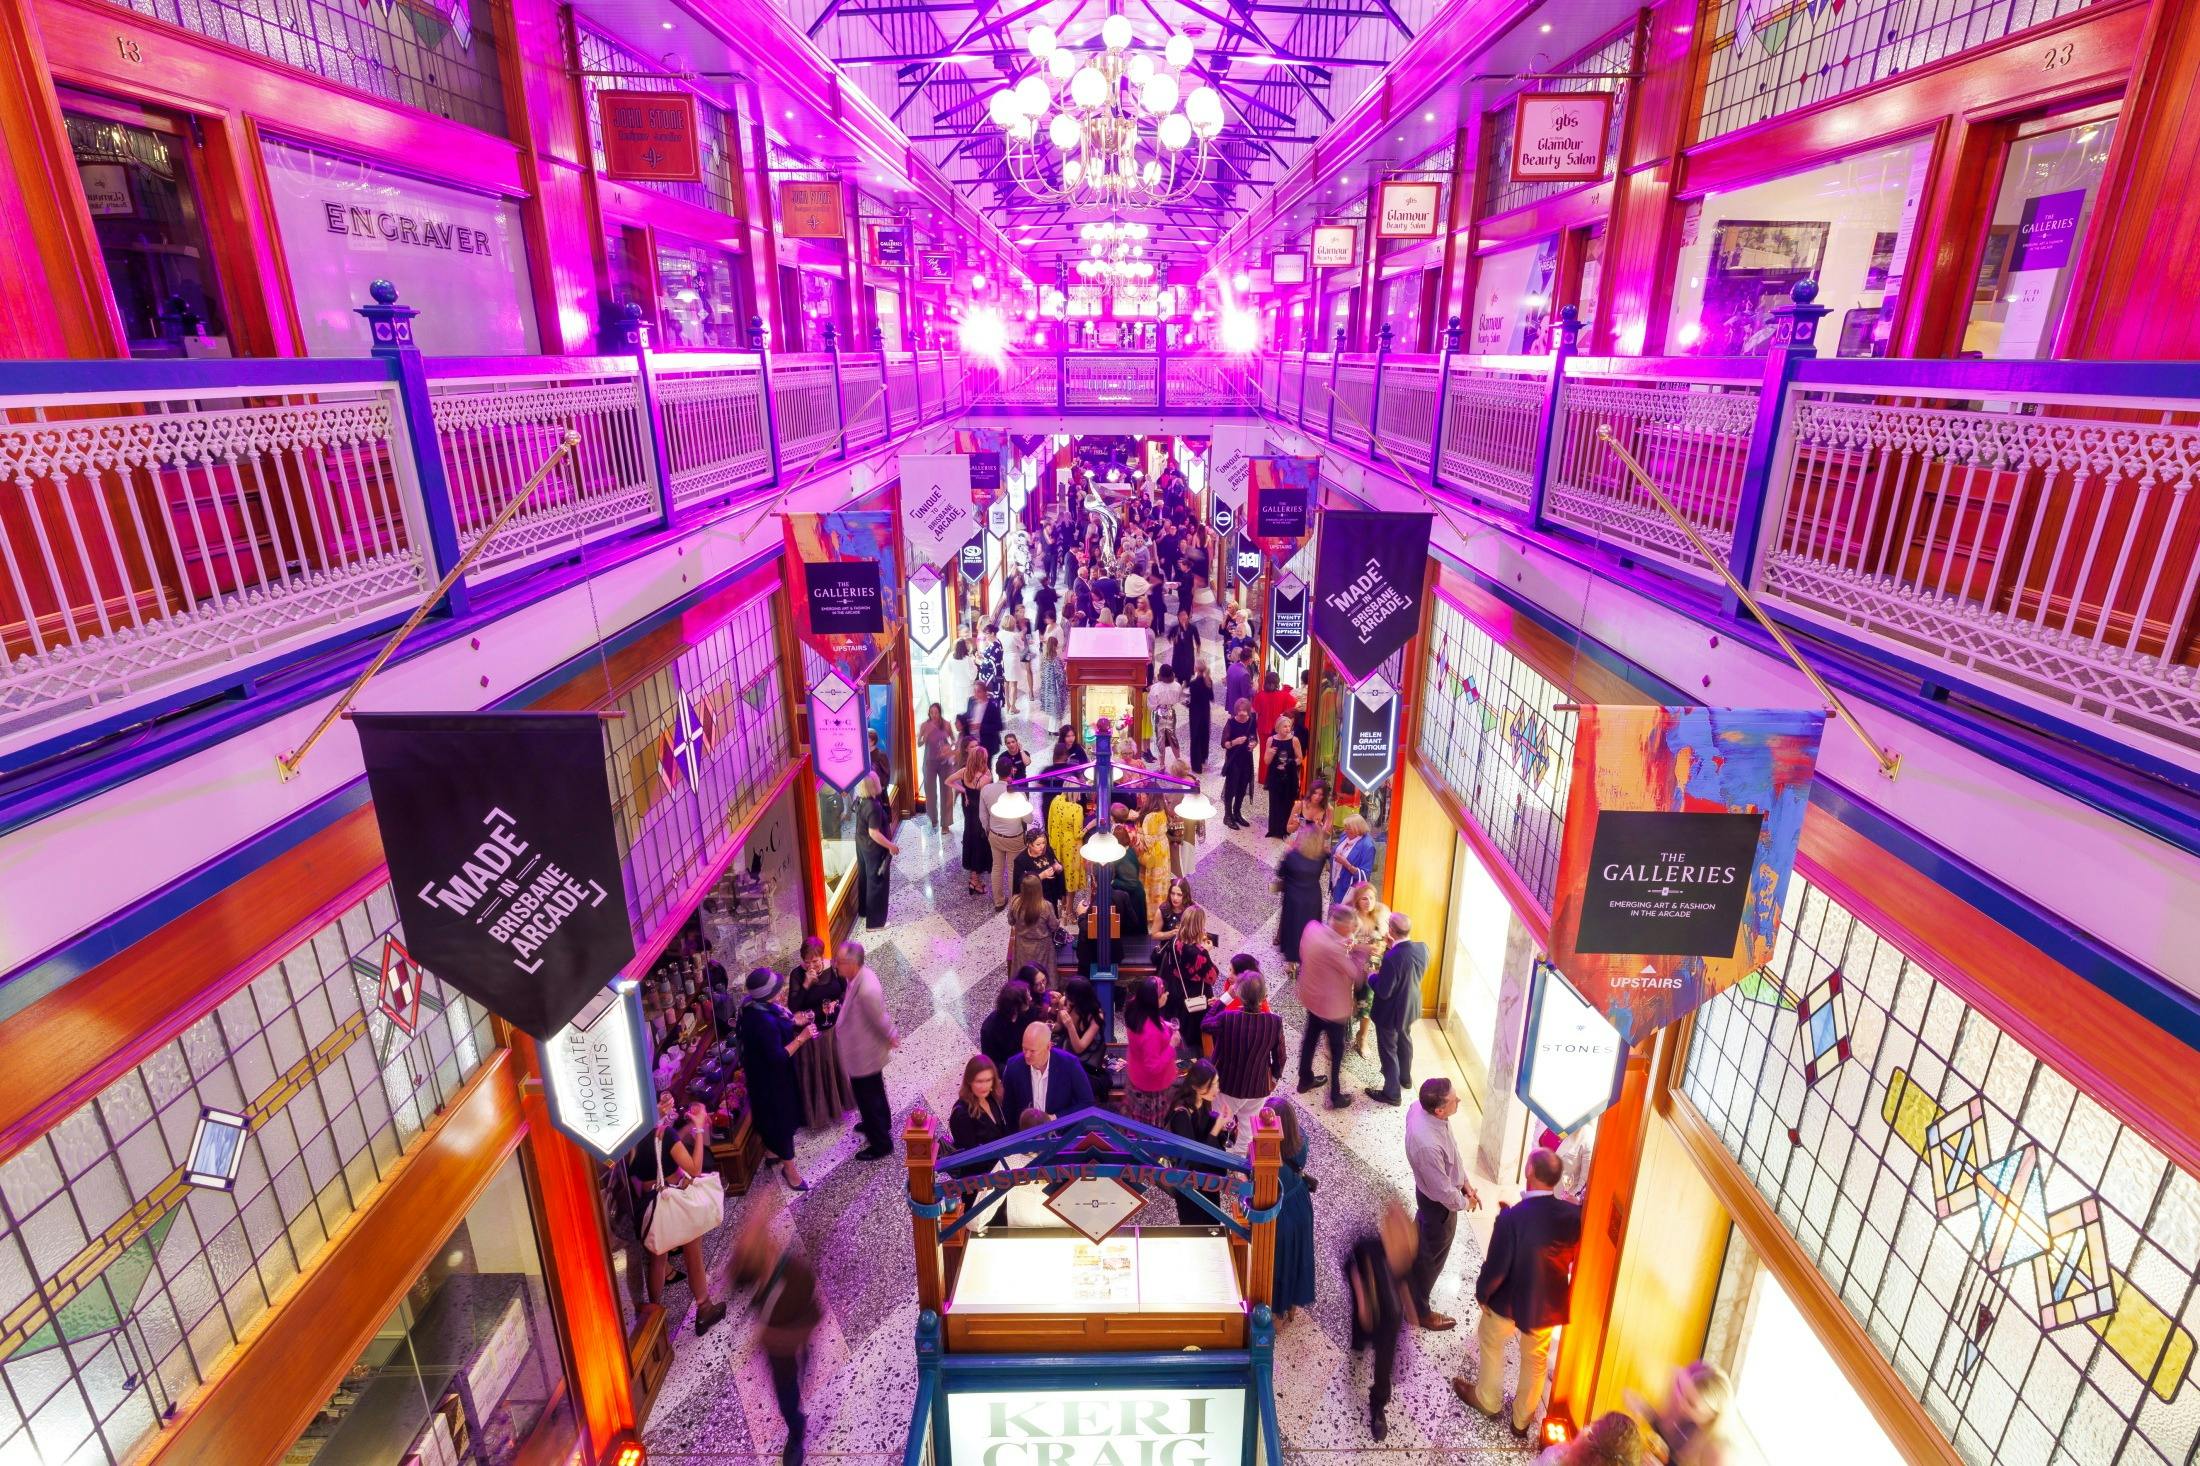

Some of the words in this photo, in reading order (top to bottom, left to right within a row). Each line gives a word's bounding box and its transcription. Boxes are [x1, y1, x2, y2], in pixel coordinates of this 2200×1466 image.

[117, 36, 142, 63] 13
[2042, 43, 2074, 72] 23
[614, 107, 643, 129] JOHN
[648, 109, 684, 130] STONE
[1556, 113, 1579, 132] gbs
[1522, 153, 1561, 169] Beauty
[1566, 152, 1596, 165] Salon
[323, 201, 492, 256] ENGRAVER
[1386, 222, 1408, 230] Beauty
[1410, 222, 1426, 230] Salon
[1387, 209, 1430, 221] Glamour
[2022, 217, 2074, 234] GALLERIES
[1219, 452, 1242, 474] UNIQUE
[914, 490, 942, 519] UNIQUE
[928, 502, 954, 531] BRISBANE
[1262, 505, 1303, 513] GALLERIES
[933, 508, 961, 538] ARCADE
[814, 587, 875, 598] GALLERIES
[1333, 566, 1383, 612] MADE
[1362, 594, 1372, 604] IN
[919, 600, 931, 635] darb
[1351, 586, 1396, 627] BRISBANE
[1360, 594, 1404, 636] ARCADE
[436, 824, 529, 916] MADE
[1660, 852, 1686, 862] THE
[1603, 864, 1736, 884] GALLERIES
[497, 878, 520, 898] IN
[488, 862, 568, 944] BRISBANE
[1609, 900, 1652, 909] EMERGING
[1679, 902, 1716, 910] FASHION
[1658, 910, 1692, 918] ARCADE
[511, 876, 590, 960] ARCADE
[1610, 977, 1683, 989] UPSTAIRS
[1542, 1044, 1614, 1054] STONES
[570, 1035, 600, 1134] CHOCOLATE
[593, 1043, 620, 1127] MOMENTS
[942, 1162, 1098, 1200] BRISBANE
[1120, 1162, 1241, 1196] ARCADE
[984, 1397, 1217, 1438] KERI
[983, 1438, 1213, 1466] CRAIG
